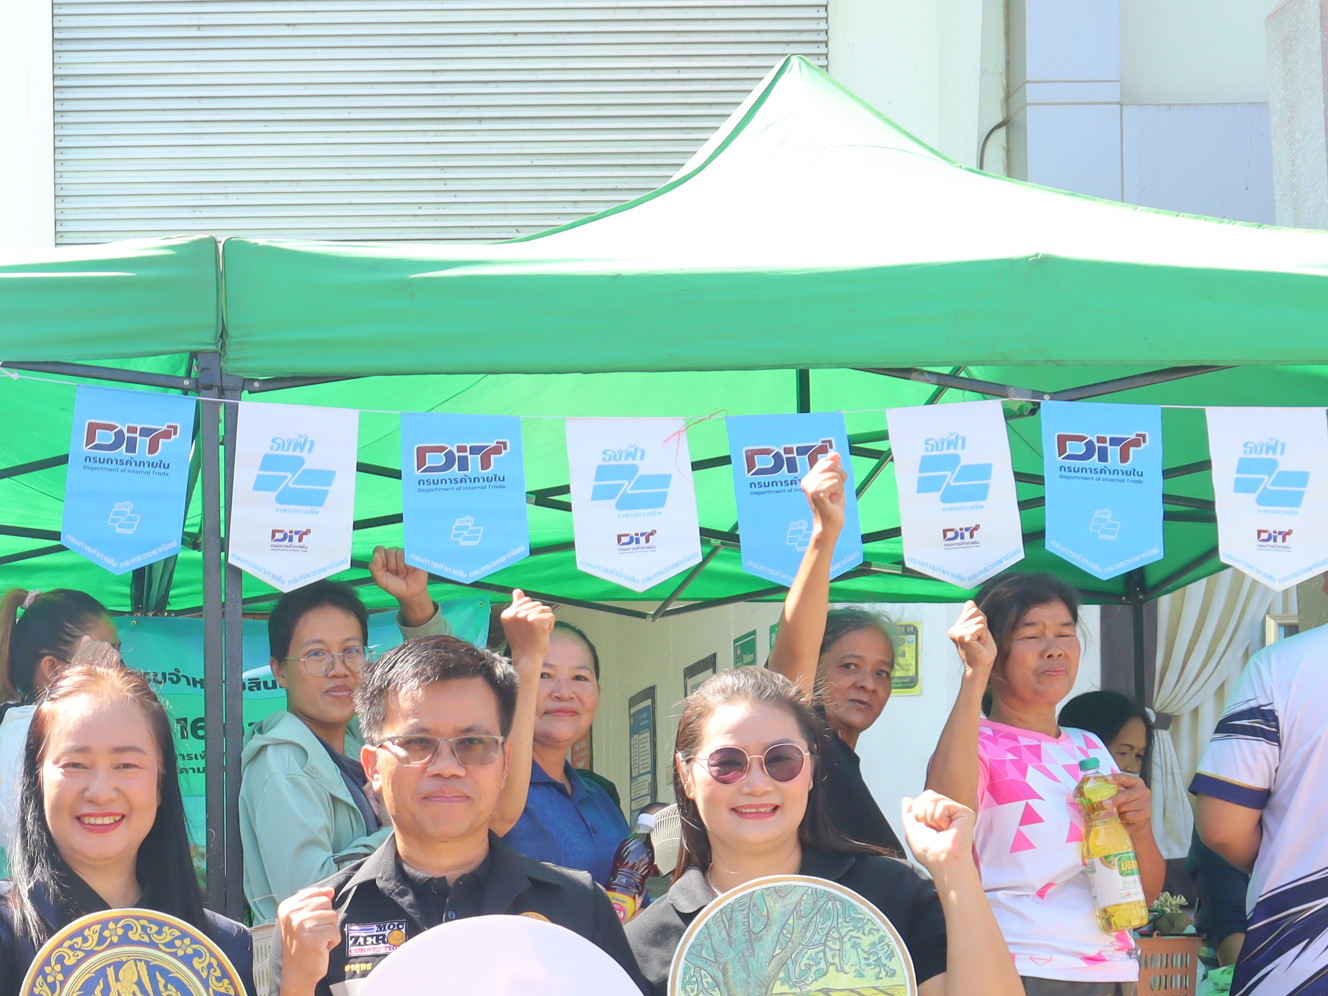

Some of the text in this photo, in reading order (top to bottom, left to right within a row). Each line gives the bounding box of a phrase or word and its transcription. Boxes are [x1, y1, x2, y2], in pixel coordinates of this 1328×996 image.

[269, 433, 315, 454] ธงฟ้า
[924, 432, 967, 453] ธงฟ้า
[1243, 436, 1287, 456] ธงฟ้า
[601, 444, 646, 463] ธงฟ้า
[84, 455, 170, 470] กรมการค้าภายใน
[83, 465, 120, 474] Department
[127, 468, 151, 476] Internal
[1059, 465, 1144, 477] กรมการค้าภายใน
[417, 474, 506, 486] กรมการค้าภายใน
[1058, 474, 1094, 482] Department
[417, 486, 455, 494] Department
[375, 922, 405, 932] MOC
